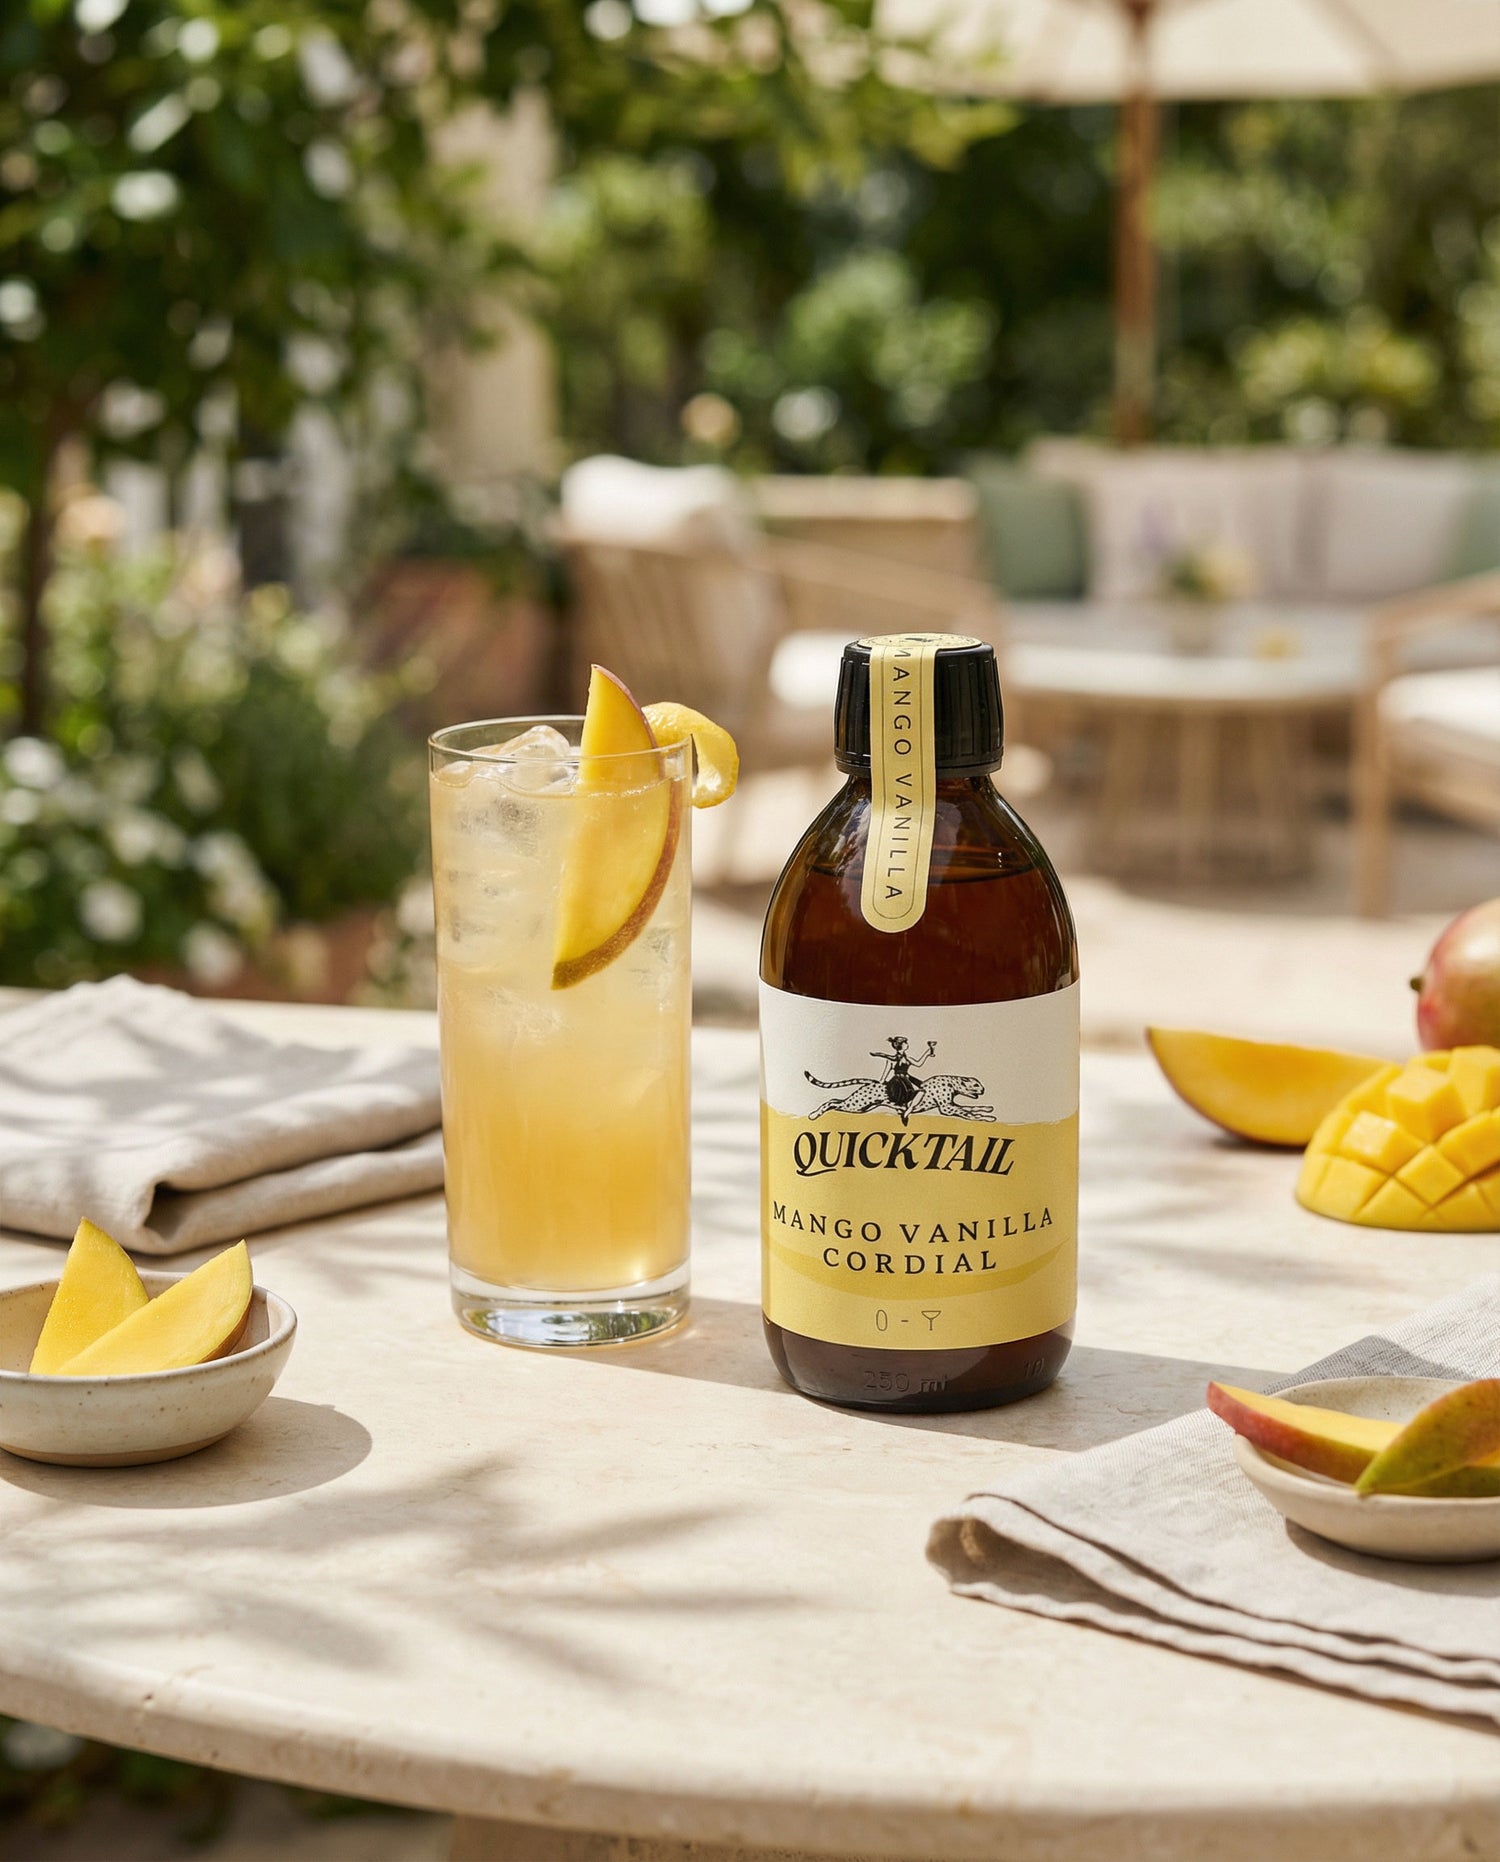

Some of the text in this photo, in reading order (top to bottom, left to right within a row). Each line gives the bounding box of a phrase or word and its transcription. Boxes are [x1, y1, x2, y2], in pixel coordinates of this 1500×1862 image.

[885, 773, 913, 900] VANILLA
[793, 1131, 1016, 1177] QUICKTAIL
[773, 1200, 1054, 1244] MANGO VANILLA
[822, 1247, 997, 1275] CORDIAL
[864, 1370, 910, 1393] 250
